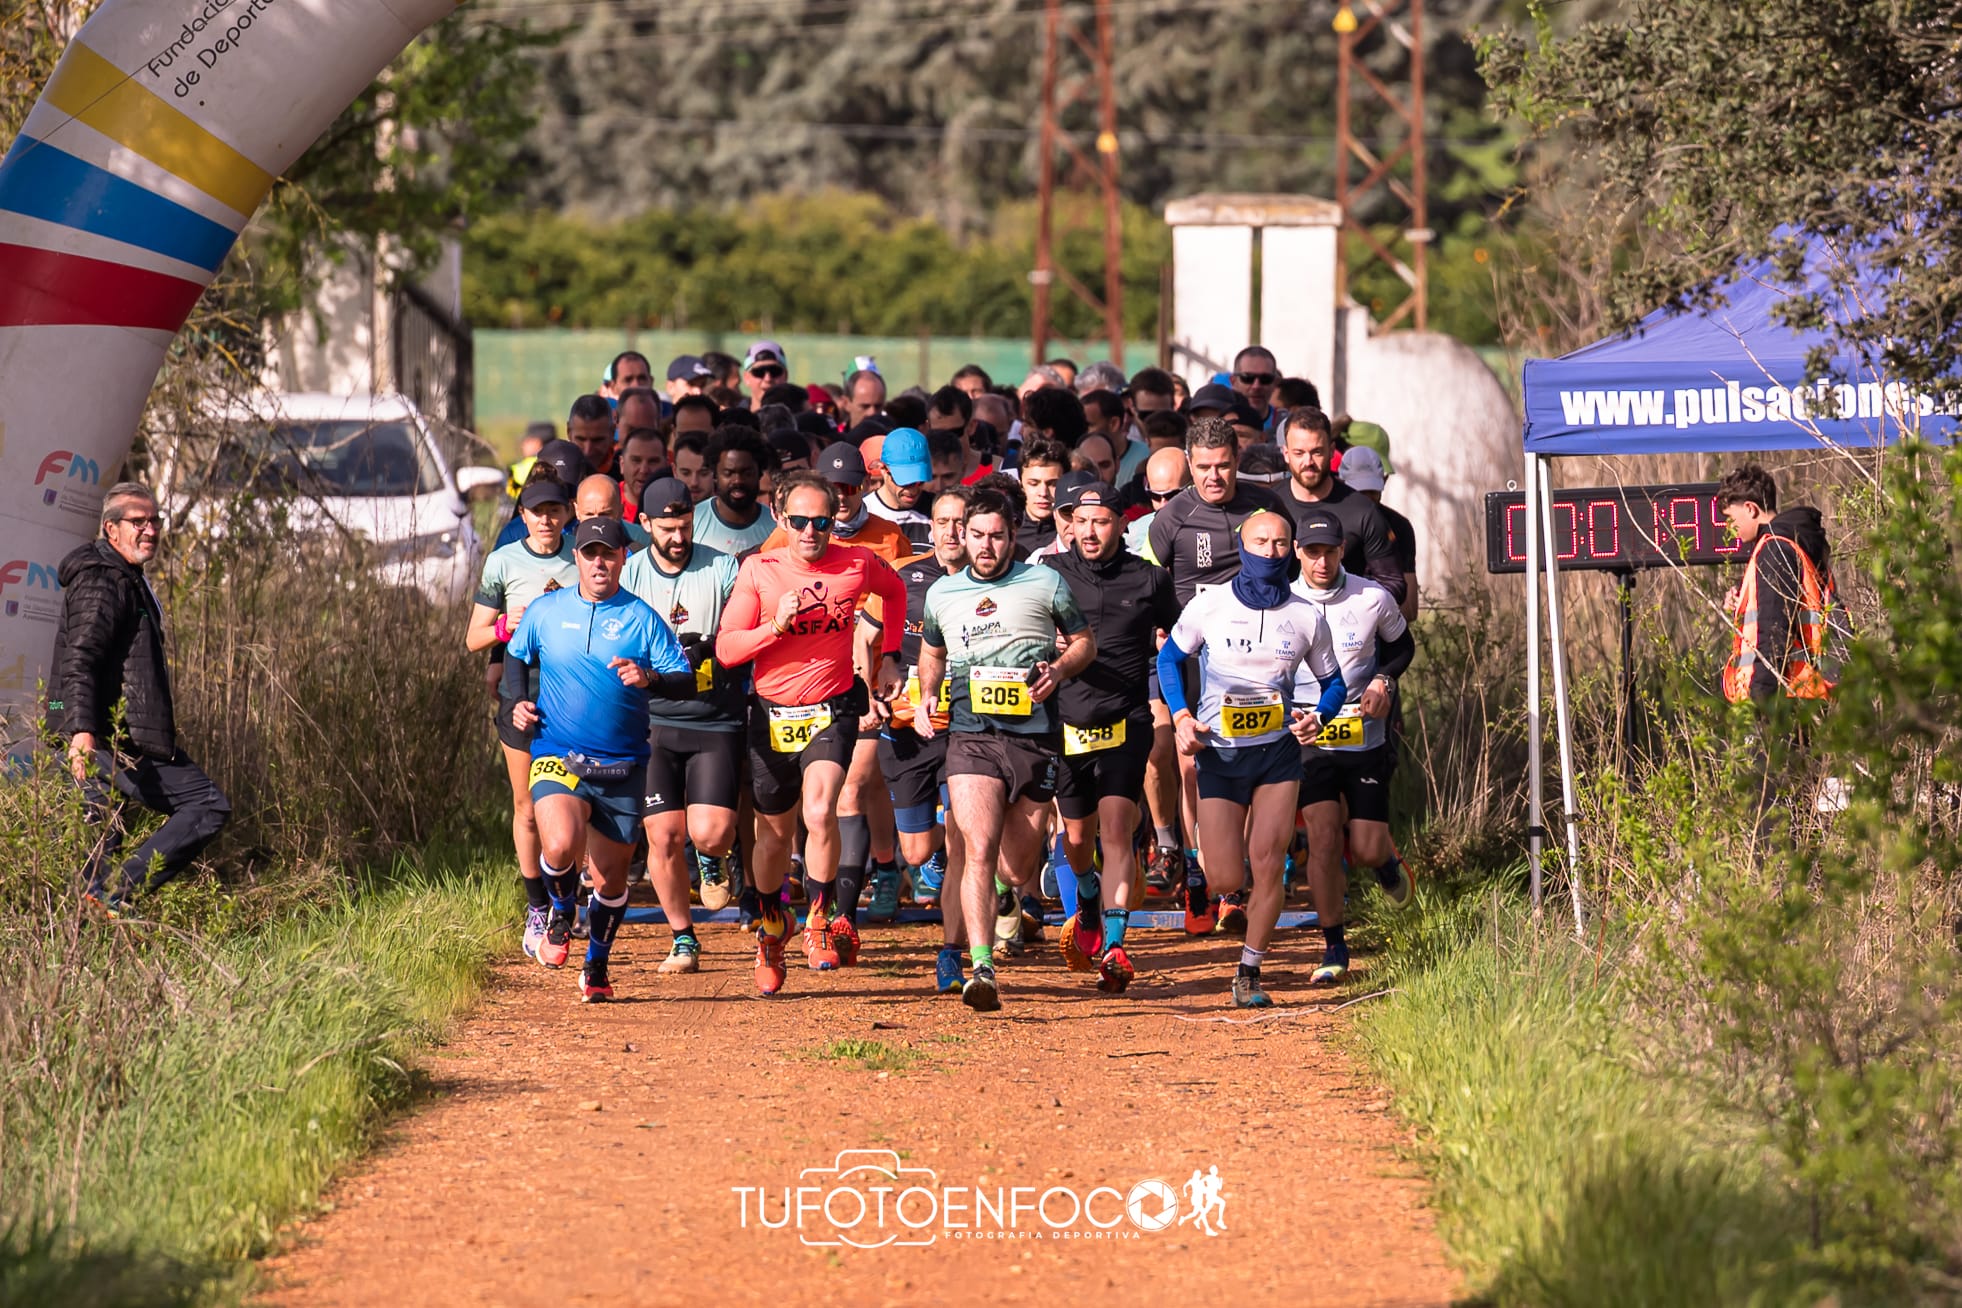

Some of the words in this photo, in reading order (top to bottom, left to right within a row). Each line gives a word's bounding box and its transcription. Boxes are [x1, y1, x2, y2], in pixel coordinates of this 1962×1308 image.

[174, 70, 201, 97] de
[197, 0, 274, 69] Deport
[981, 687, 1020, 706] 205
[1232, 711, 1271, 730] 287
